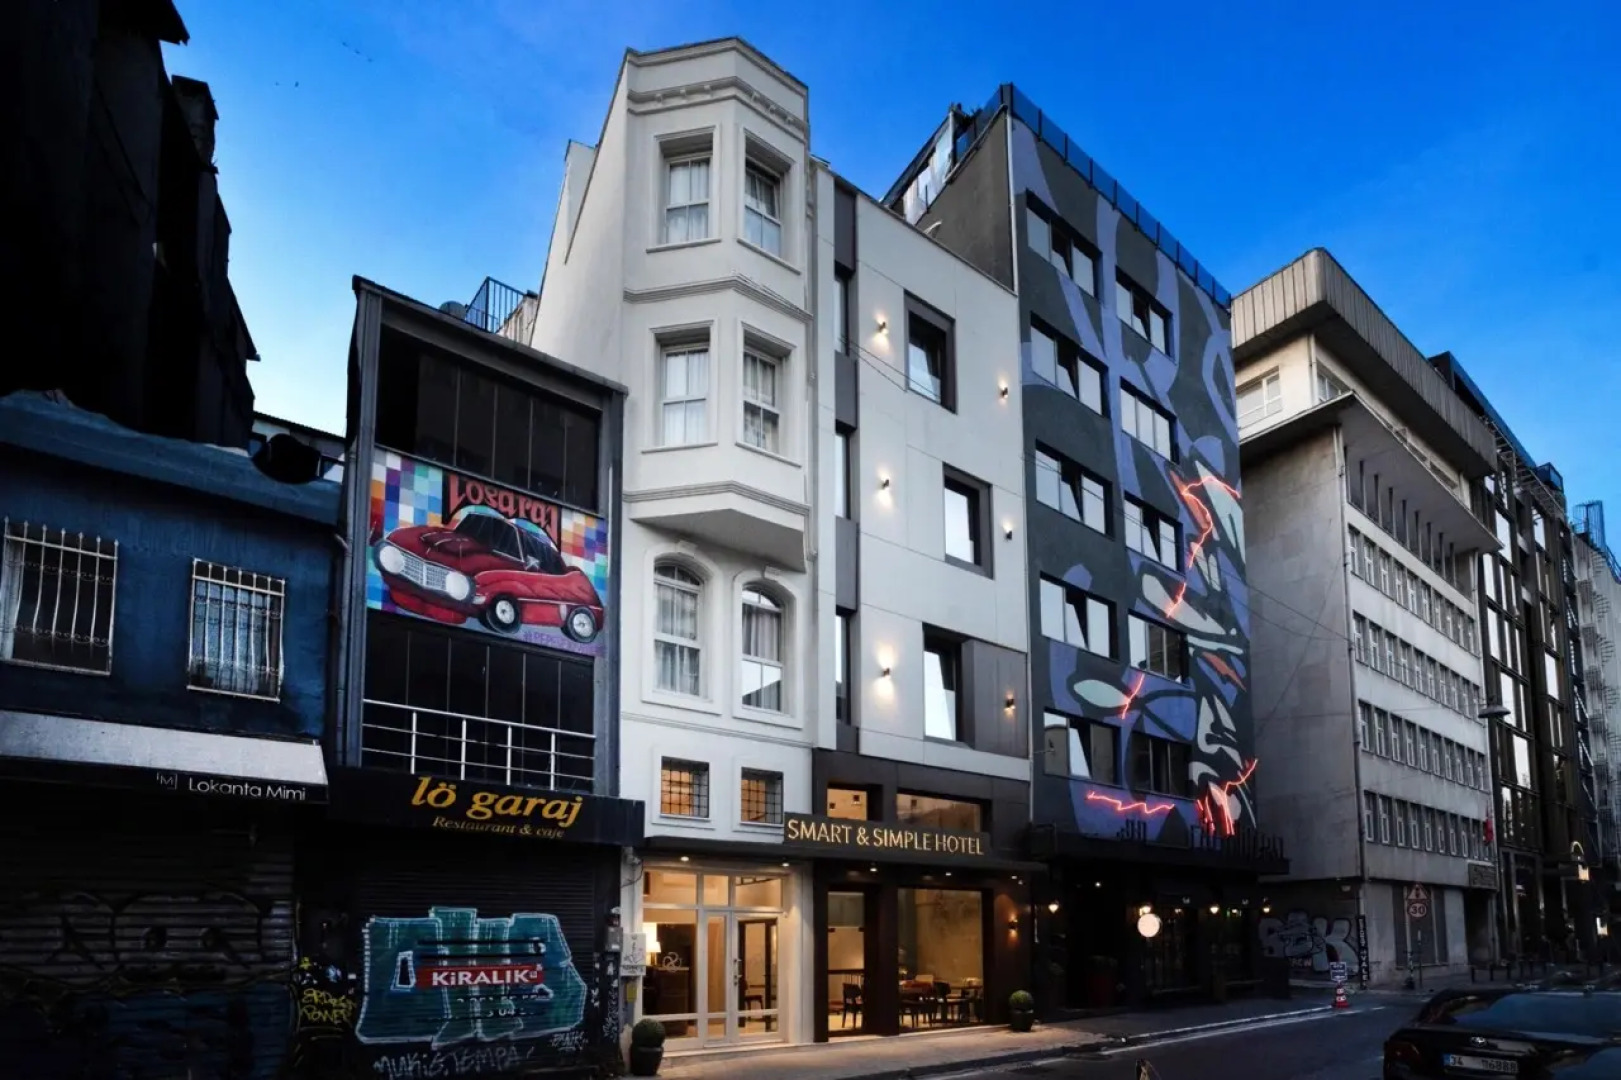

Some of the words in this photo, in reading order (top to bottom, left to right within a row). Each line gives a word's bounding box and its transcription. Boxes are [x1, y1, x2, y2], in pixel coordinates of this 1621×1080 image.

[189, 777, 262, 798] Lokanta
[266, 784, 306, 801] Mimi
[411, 776, 457, 808] lö
[465, 791, 583, 829] garaj
[432, 815, 517, 835] Restaurant
[519, 823, 533, 836] &
[787, 818, 852, 844] SMART
[856, 826, 870, 846] &
[873, 828, 933, 851] SIMPLE
[935, 834, 985, 856] HOTEL
[1411, 904, 1426, 915] 30
